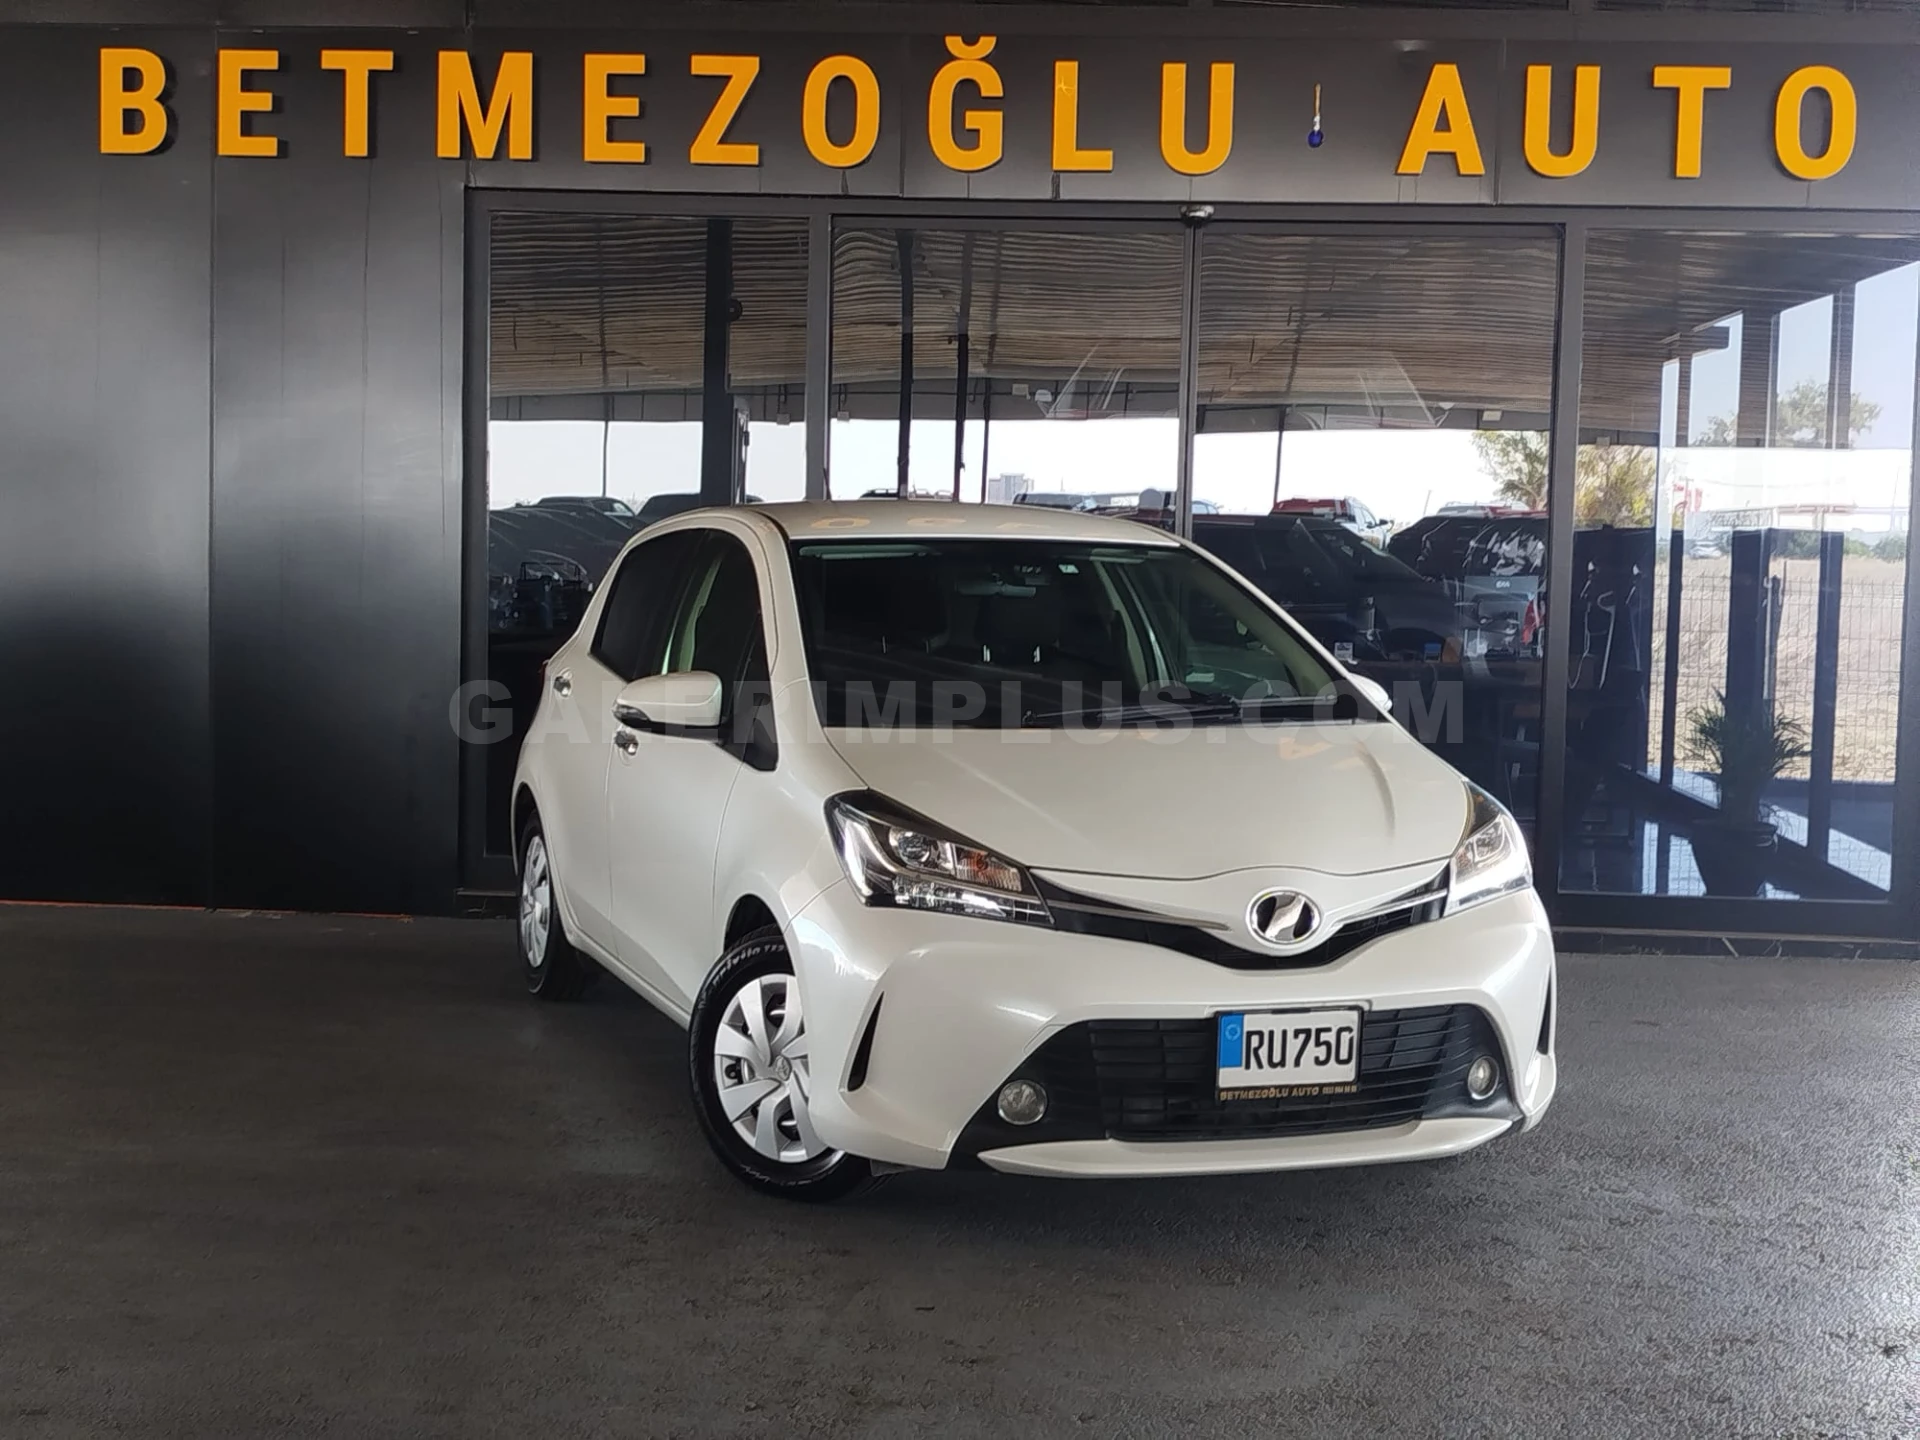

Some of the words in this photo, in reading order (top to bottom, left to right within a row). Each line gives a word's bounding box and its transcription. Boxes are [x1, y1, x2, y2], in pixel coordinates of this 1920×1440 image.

[100, 36, 1235, 175] BETMEZOĞLU
[1396, 64, 1857, 181] AUTO
[1245, 1026, 1354, 1070] RU750
[1291, 1085, 1320, 1096] AUTO
